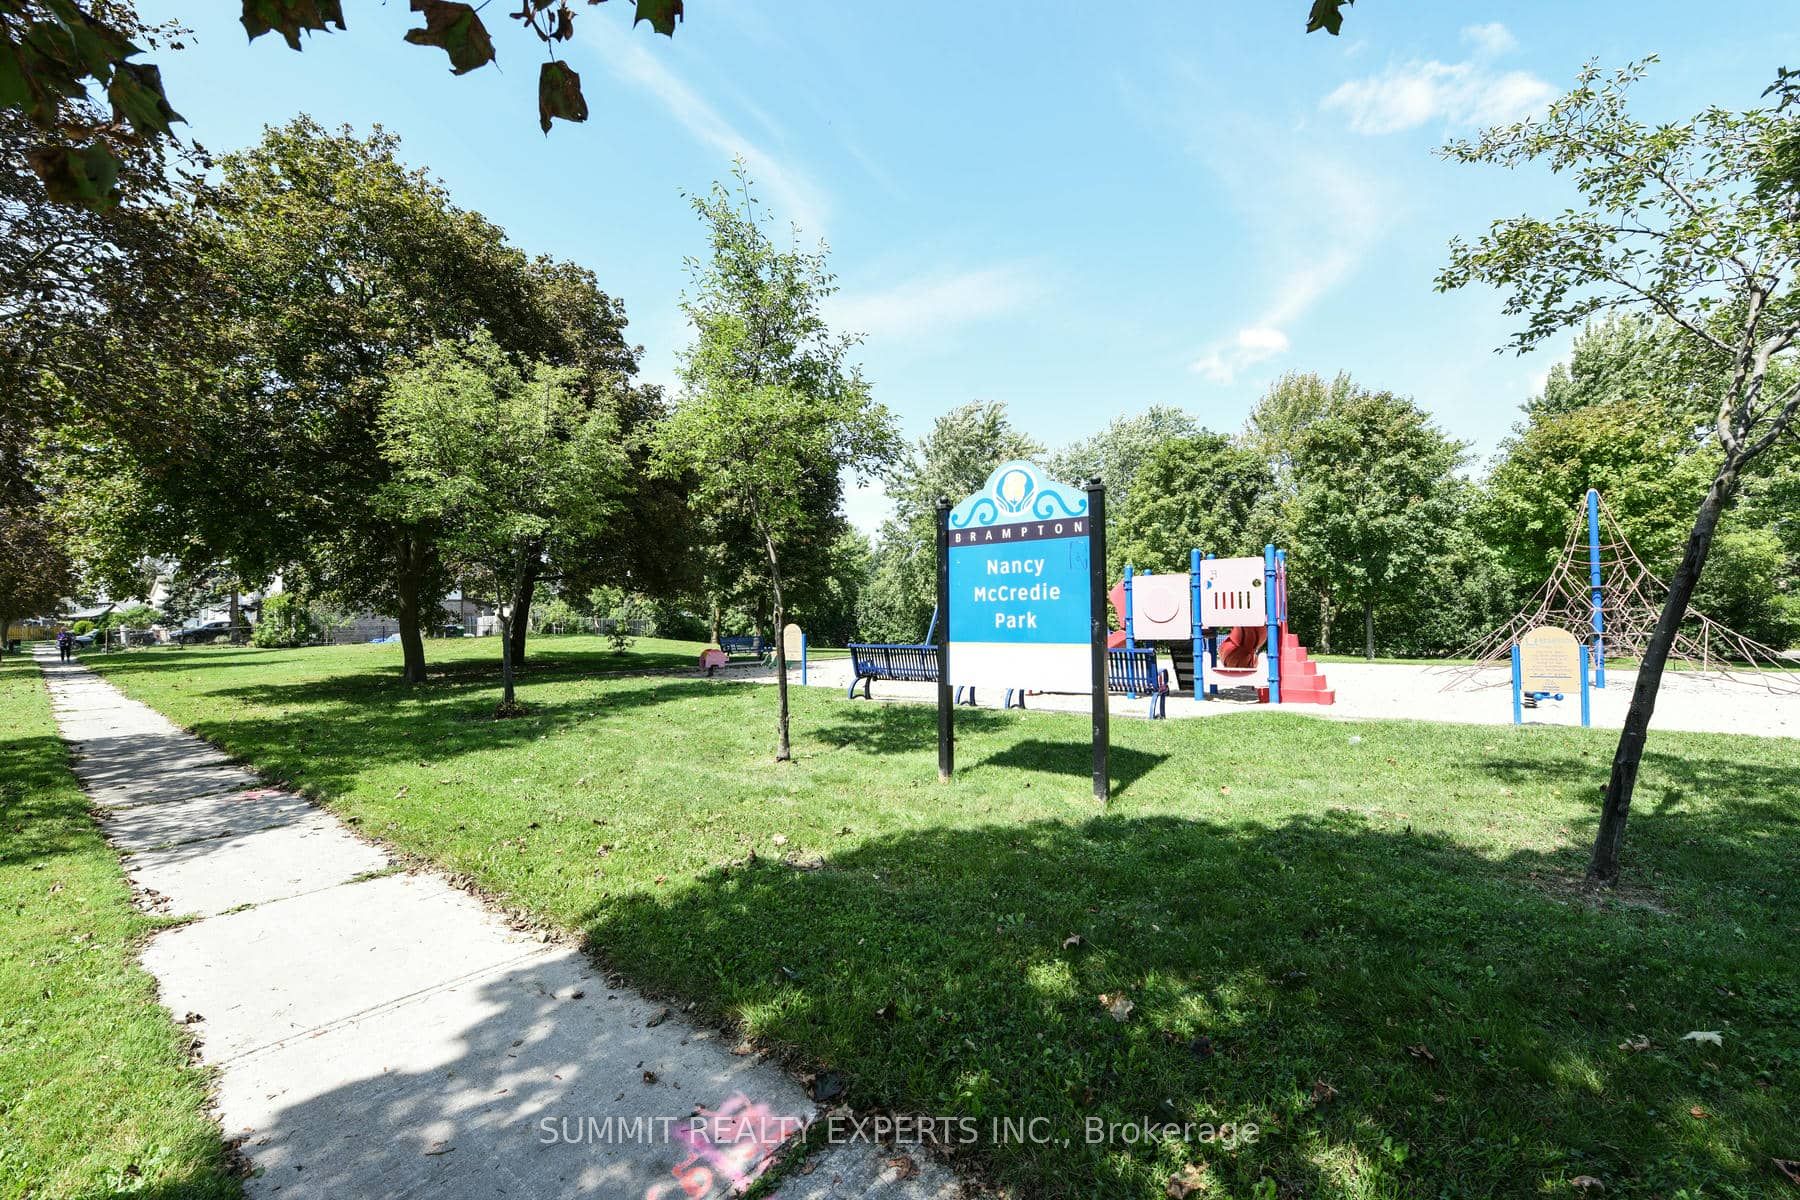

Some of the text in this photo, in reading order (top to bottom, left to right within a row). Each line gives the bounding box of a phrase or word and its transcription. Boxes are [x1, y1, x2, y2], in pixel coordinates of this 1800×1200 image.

[955, 521, 1083, 543] BRAMPTON
[986, 559, 1045, 577] Nancy
[973, 583, 1062, 603] McCredie
[995, 611, 1038, 629] Park
